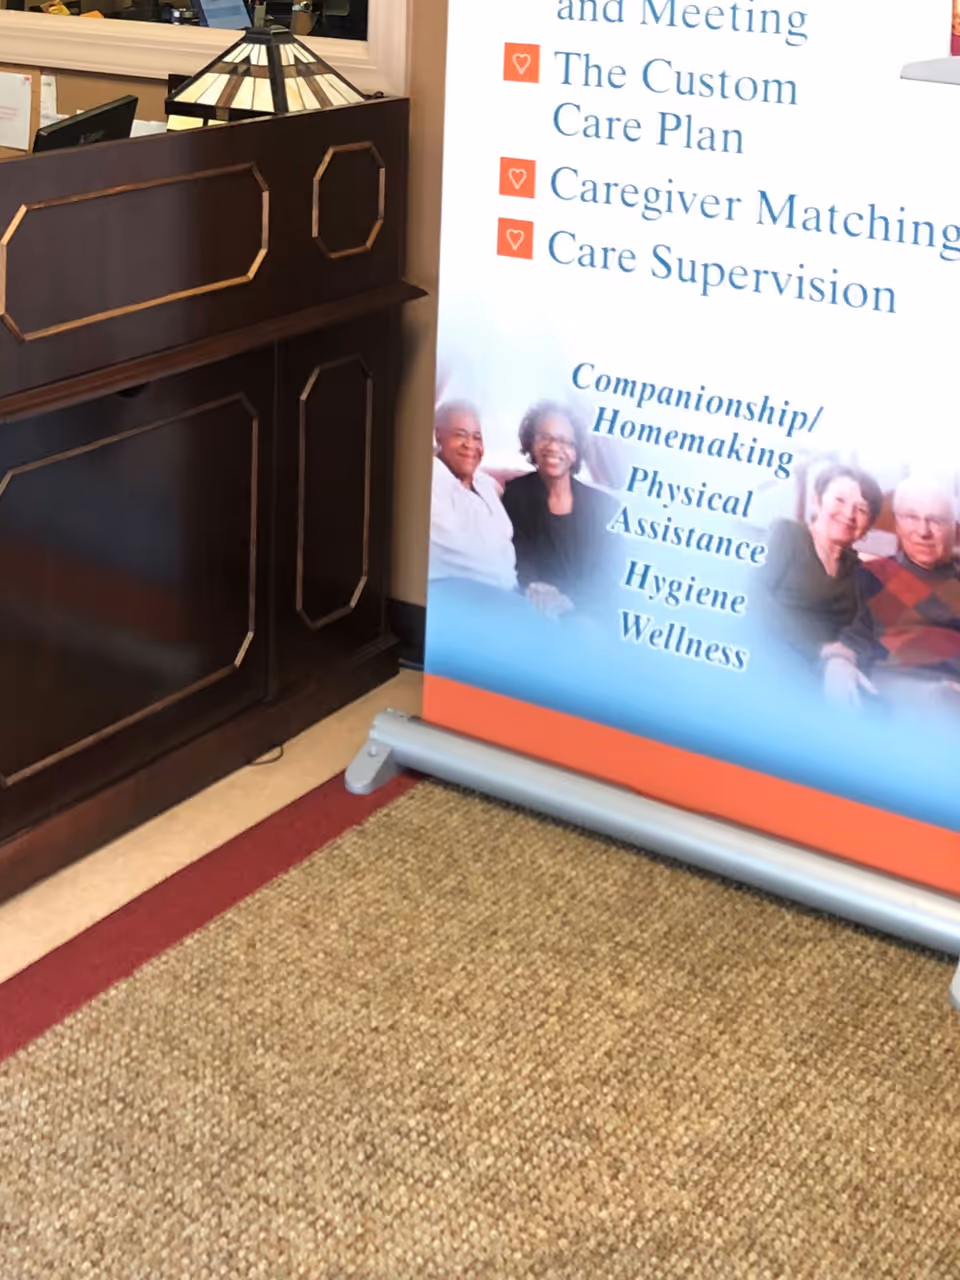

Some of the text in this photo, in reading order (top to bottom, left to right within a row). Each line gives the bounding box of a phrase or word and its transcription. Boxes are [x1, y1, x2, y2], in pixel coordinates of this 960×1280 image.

[554, 51, 798, 104] The Custom
[553, 103, 744, 154] Care Plan
[550, 166, 960, 261] Caregiver Matching
[548, 231, 897, 314] Care Supervision
[571, 361, 824, 436] Companionship/
[593, 408, 794, 478] Homemaking
[625, 466, 753, 518] Physical
[610, 507, 767, 565] Assistance
[624, 561, 746, 615] Hygiene
[619, 610, 747, 669] Wellness
